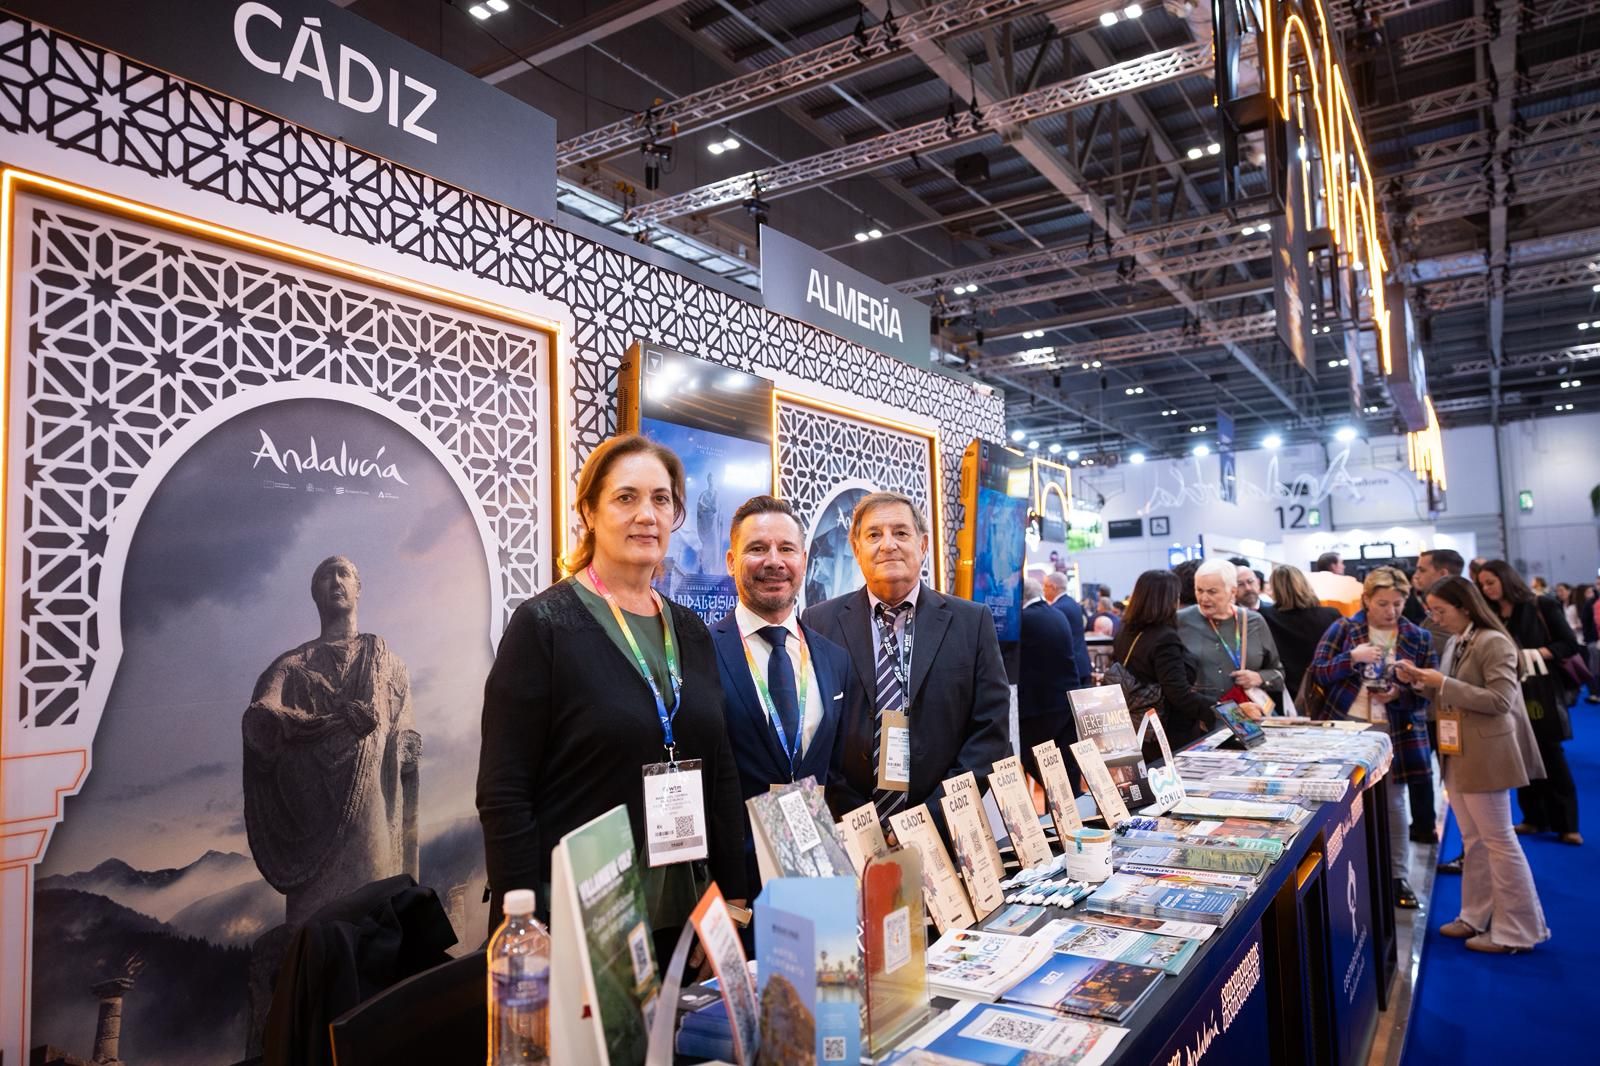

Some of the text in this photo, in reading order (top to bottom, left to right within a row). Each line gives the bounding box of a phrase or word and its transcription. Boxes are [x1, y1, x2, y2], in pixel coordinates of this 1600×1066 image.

[233, 1, 438, 144] CÁDIZ
[806, 268, 904, 343] ALMERÍA
[250, 428, 409, 486] Andalucía
[1275, 504, 1307, 530] 12
[949, 795, 970, 813] CÁDIZ
[1160, 790, 1181, 806] CONIL
[852, 810, 873, 831] CÁDIZ
[900, 812, 926, 831] CÁDIZ
